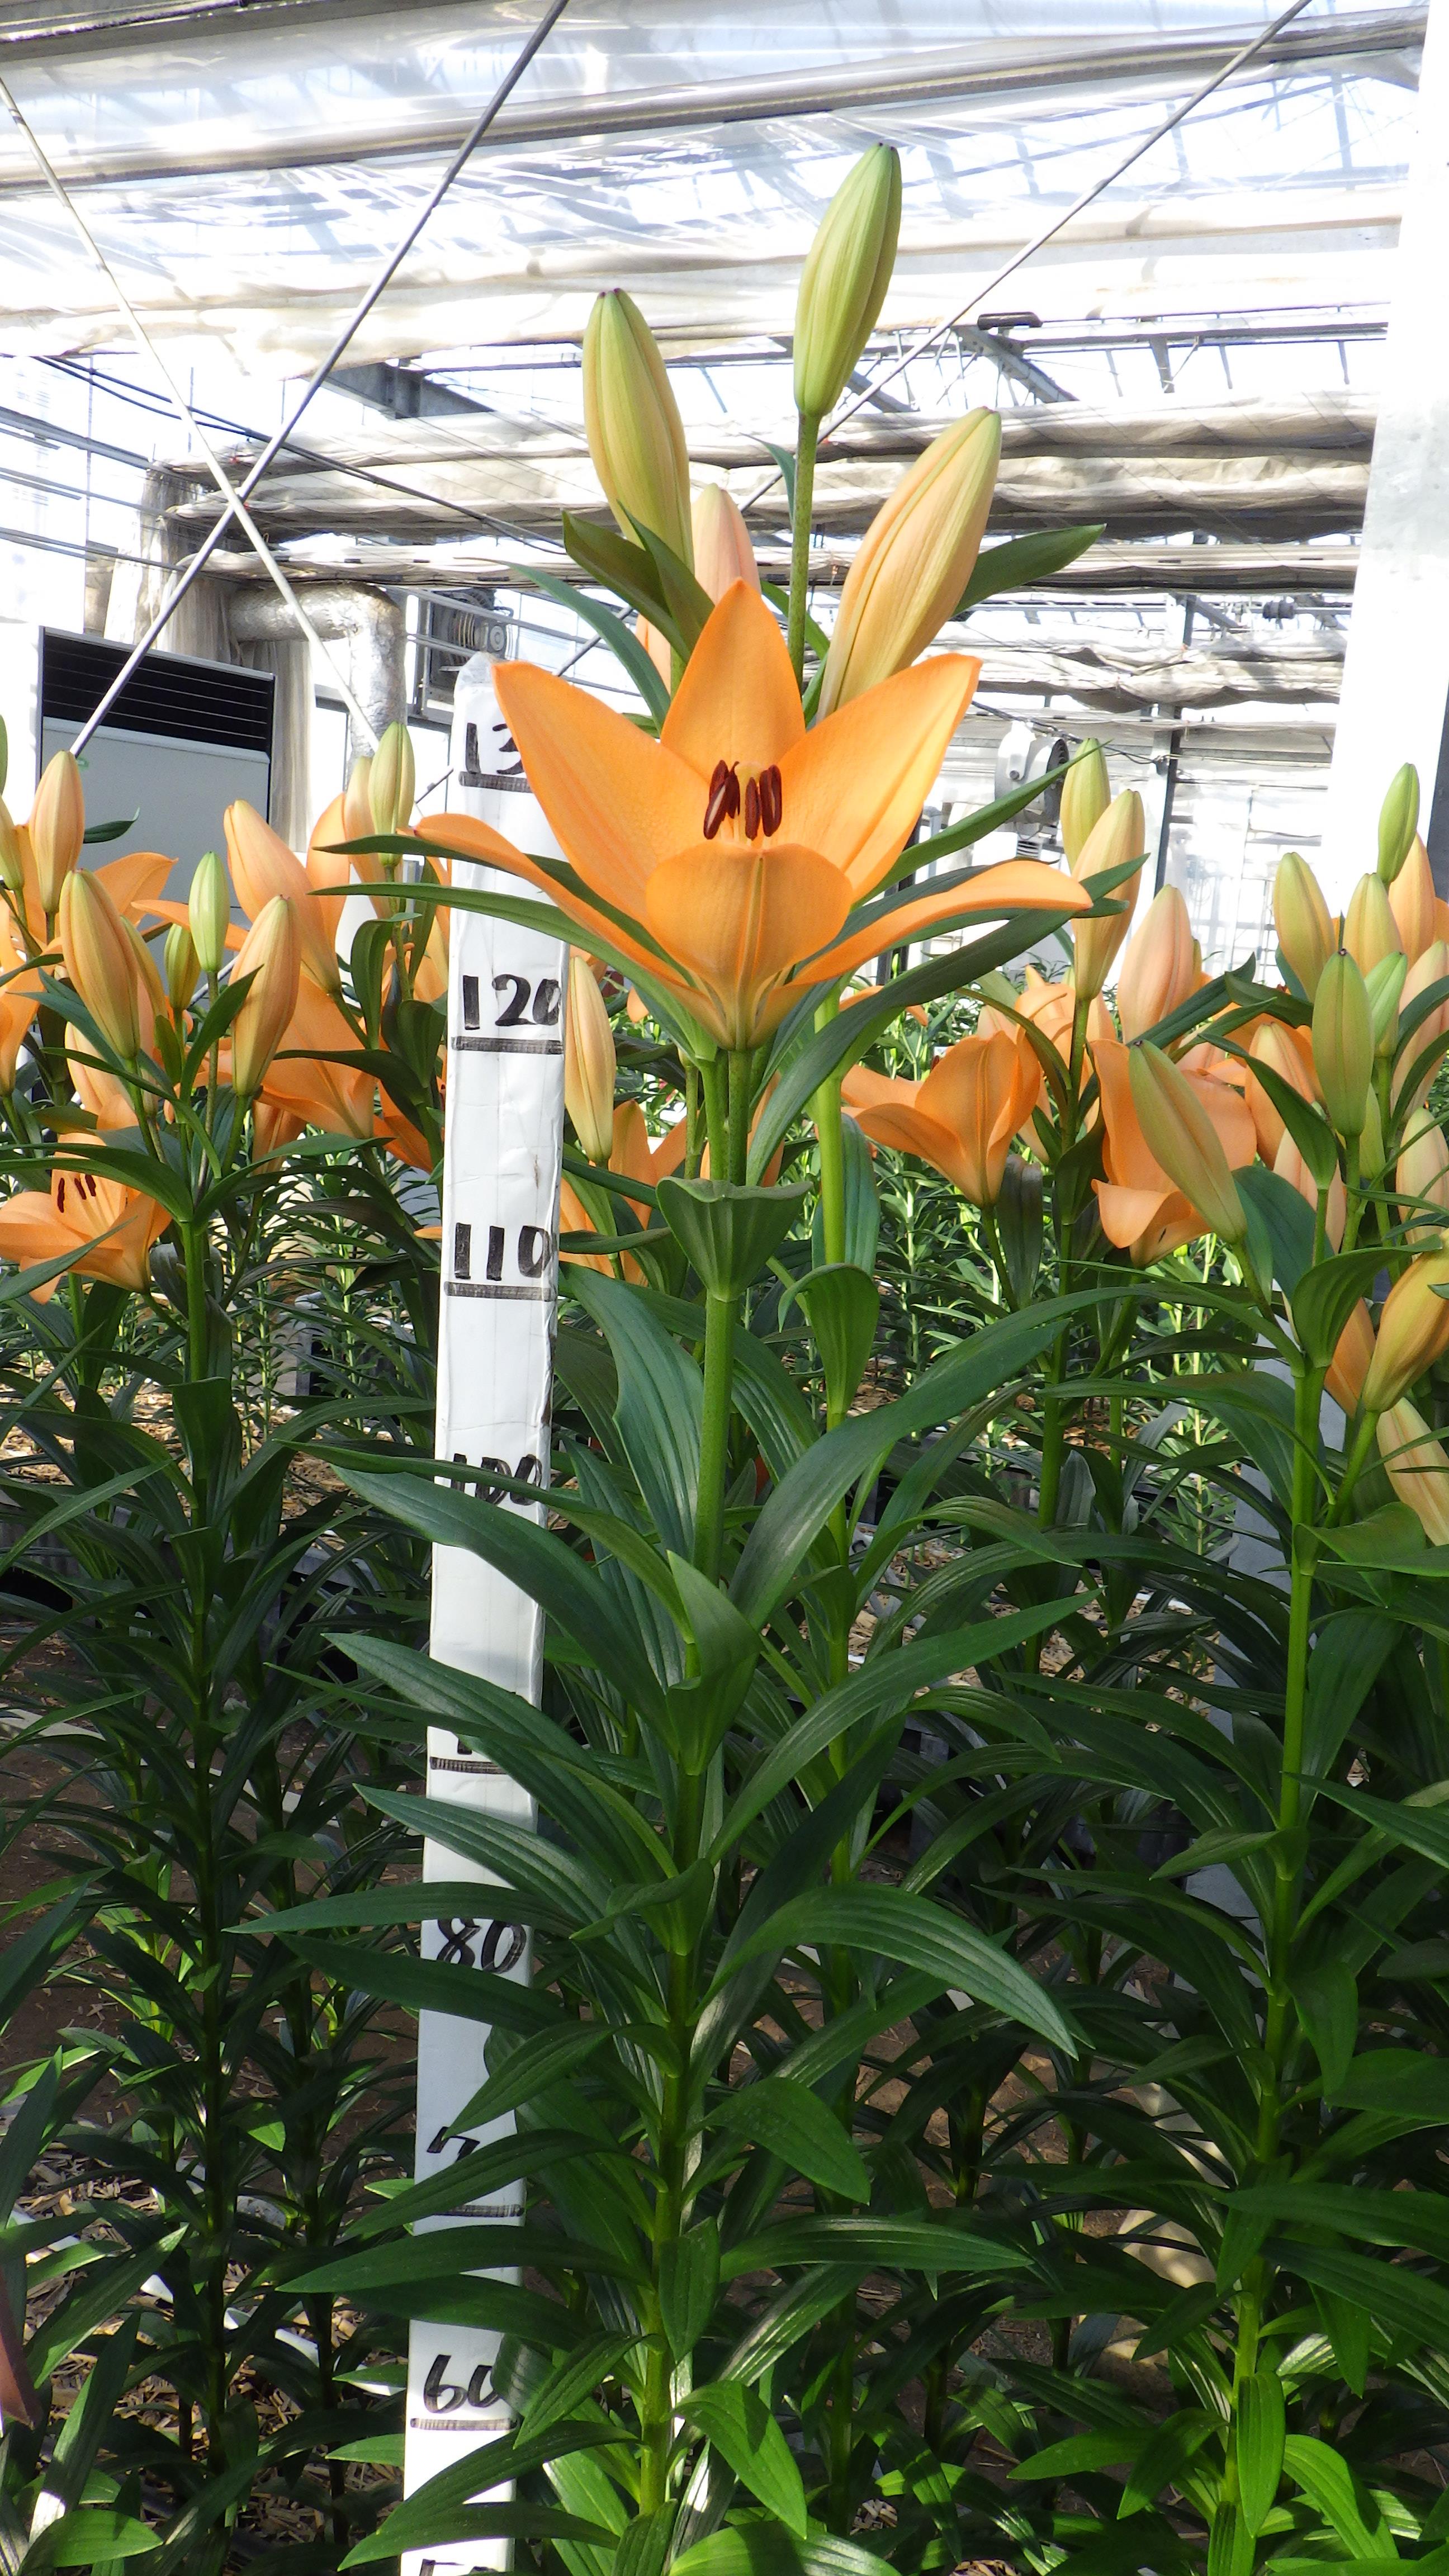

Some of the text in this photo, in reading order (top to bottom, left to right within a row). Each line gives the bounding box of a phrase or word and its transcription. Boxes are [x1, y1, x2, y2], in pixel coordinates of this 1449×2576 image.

[465, 722, 524, 775] 13
[462, 973, 561, 1030] 120
[454, 1222, 551, 1281] 110
[436, 1918, 527, 1974] 80
[427, 2126, 480, 2162] 7
[423, 2354, 499, 2413] 60
